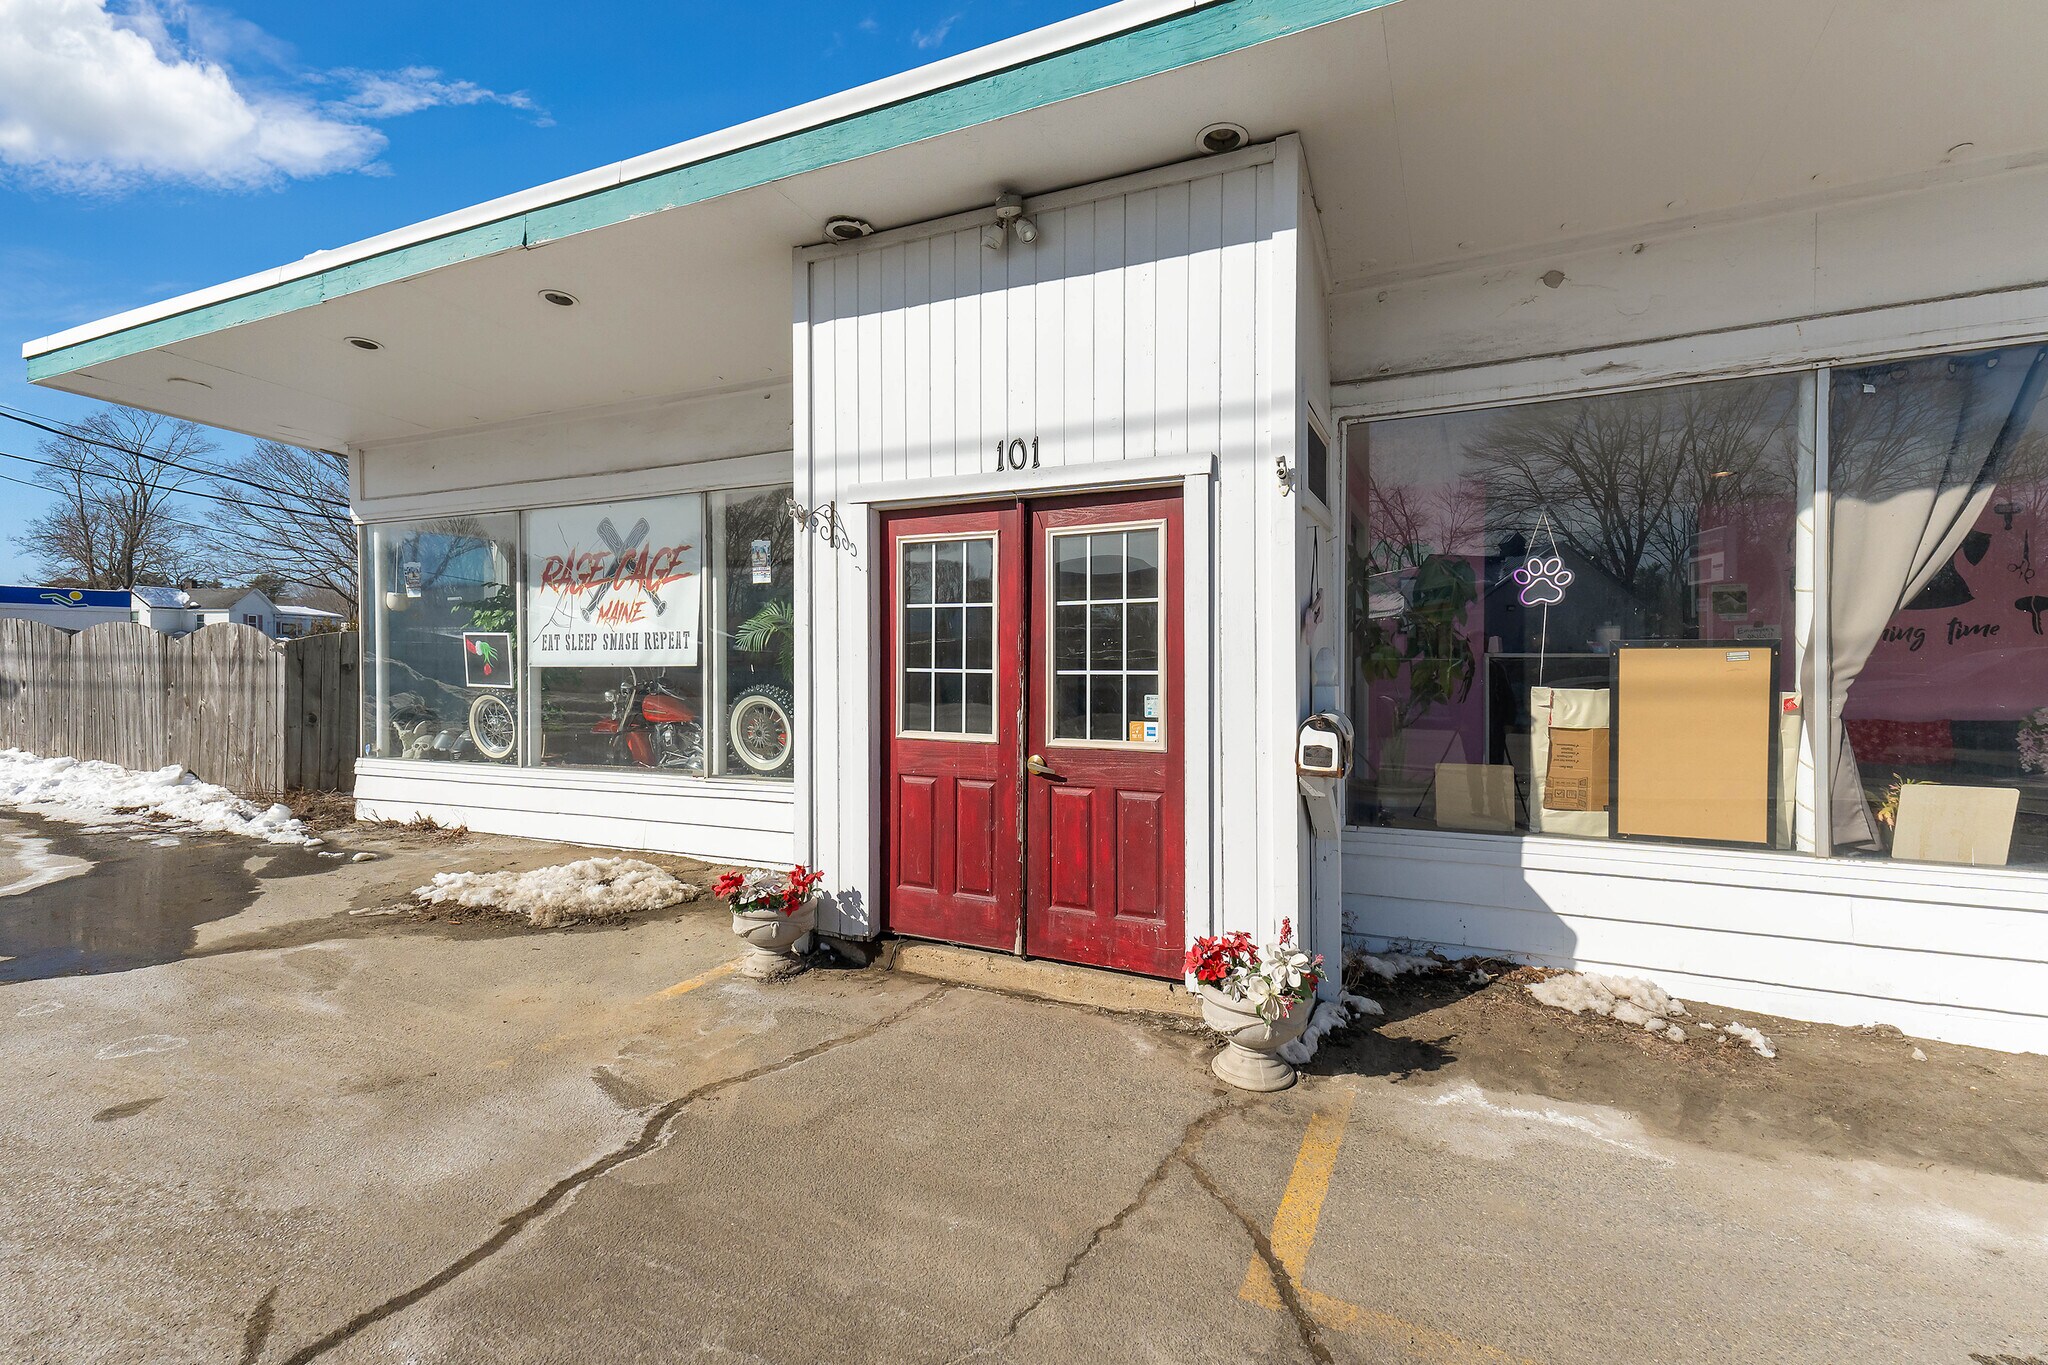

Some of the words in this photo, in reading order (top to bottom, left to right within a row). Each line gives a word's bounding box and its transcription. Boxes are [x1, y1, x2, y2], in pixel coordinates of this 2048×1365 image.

[996, 436, 1041, 472] 101
[540, 547, 613, 599] RAGE
[612, 542, 693, 600] CAGE
[595, 600, 647, 627] MAINE
[541, 633, 561, 651] EAT
[565, 632, 598, 651] SLEEP
[602, 631, 639, 650] SMASH
[644, 630, 690, 650] REPEAT
[1947, 617, 2000, 645] time
